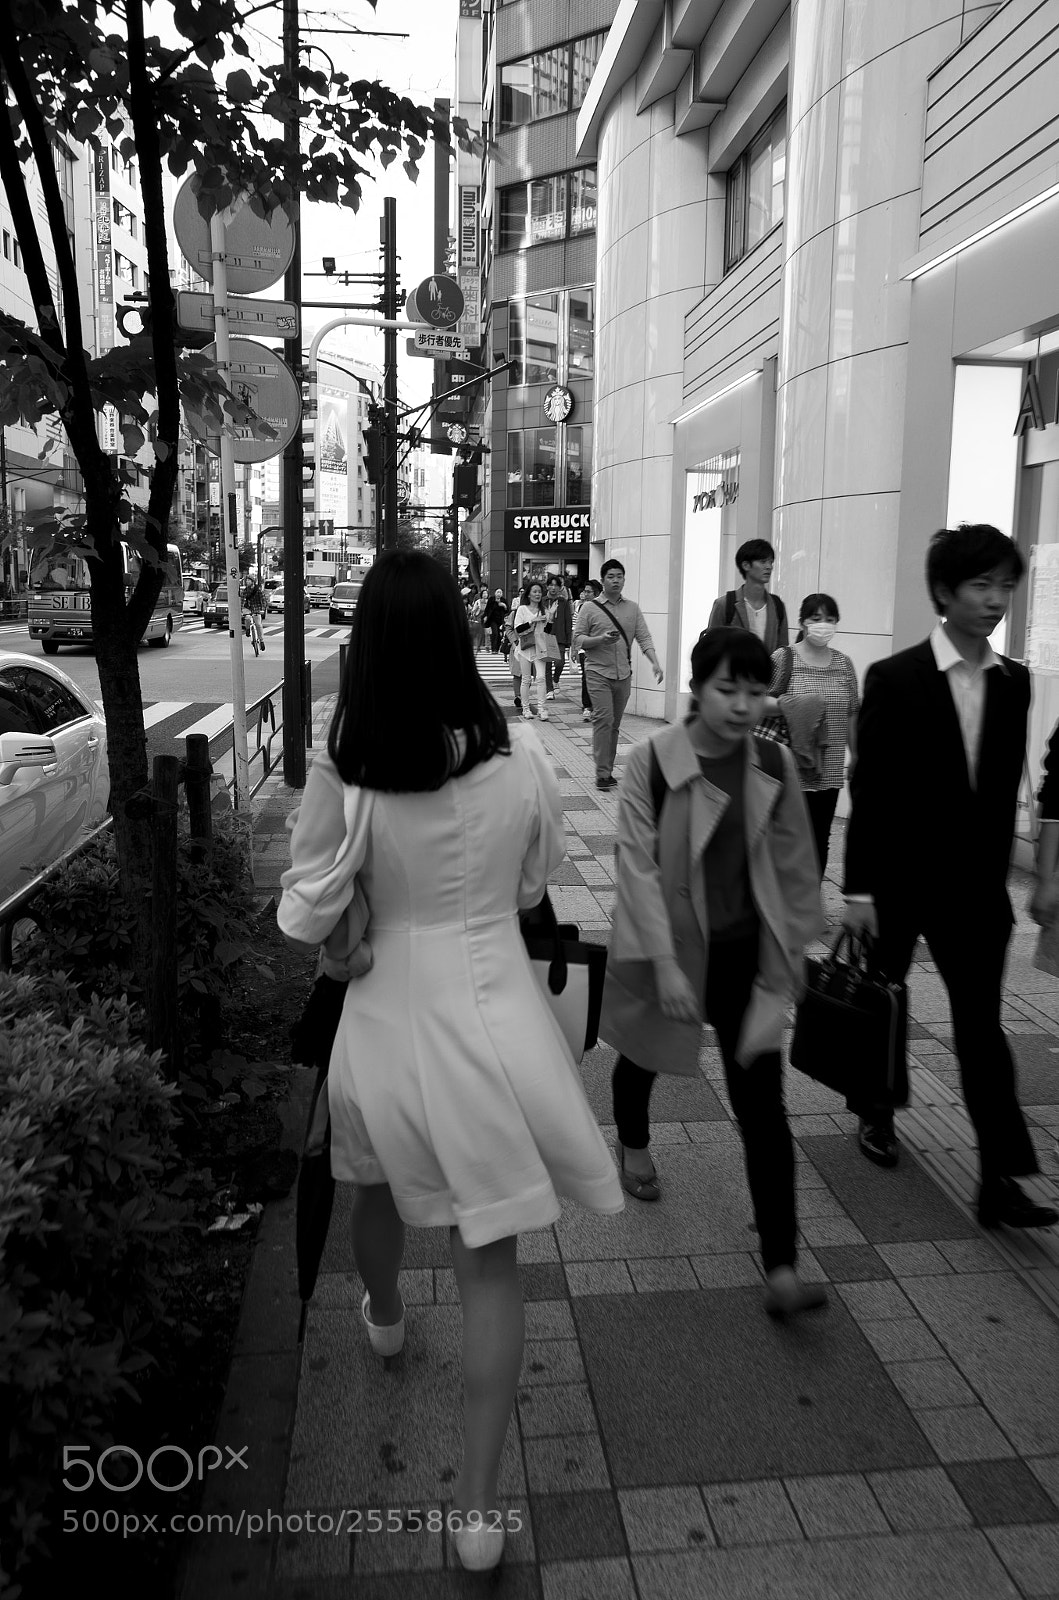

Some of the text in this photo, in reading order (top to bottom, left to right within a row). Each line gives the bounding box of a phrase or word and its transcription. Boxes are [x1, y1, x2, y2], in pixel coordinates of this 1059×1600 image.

[463, 191, 476, 218] mini
[463, 226, 476, 252] mini
[466, 268, 479, 276] 4F
[462, 286, 479, 321] 歯科
[418, 333, 462, 348] 歩行者優先
[513, 513, 590, 529] STARBUCK
[529, 530, 582, 544] COFFEE
[52, 596, 91, 610] SEIB
